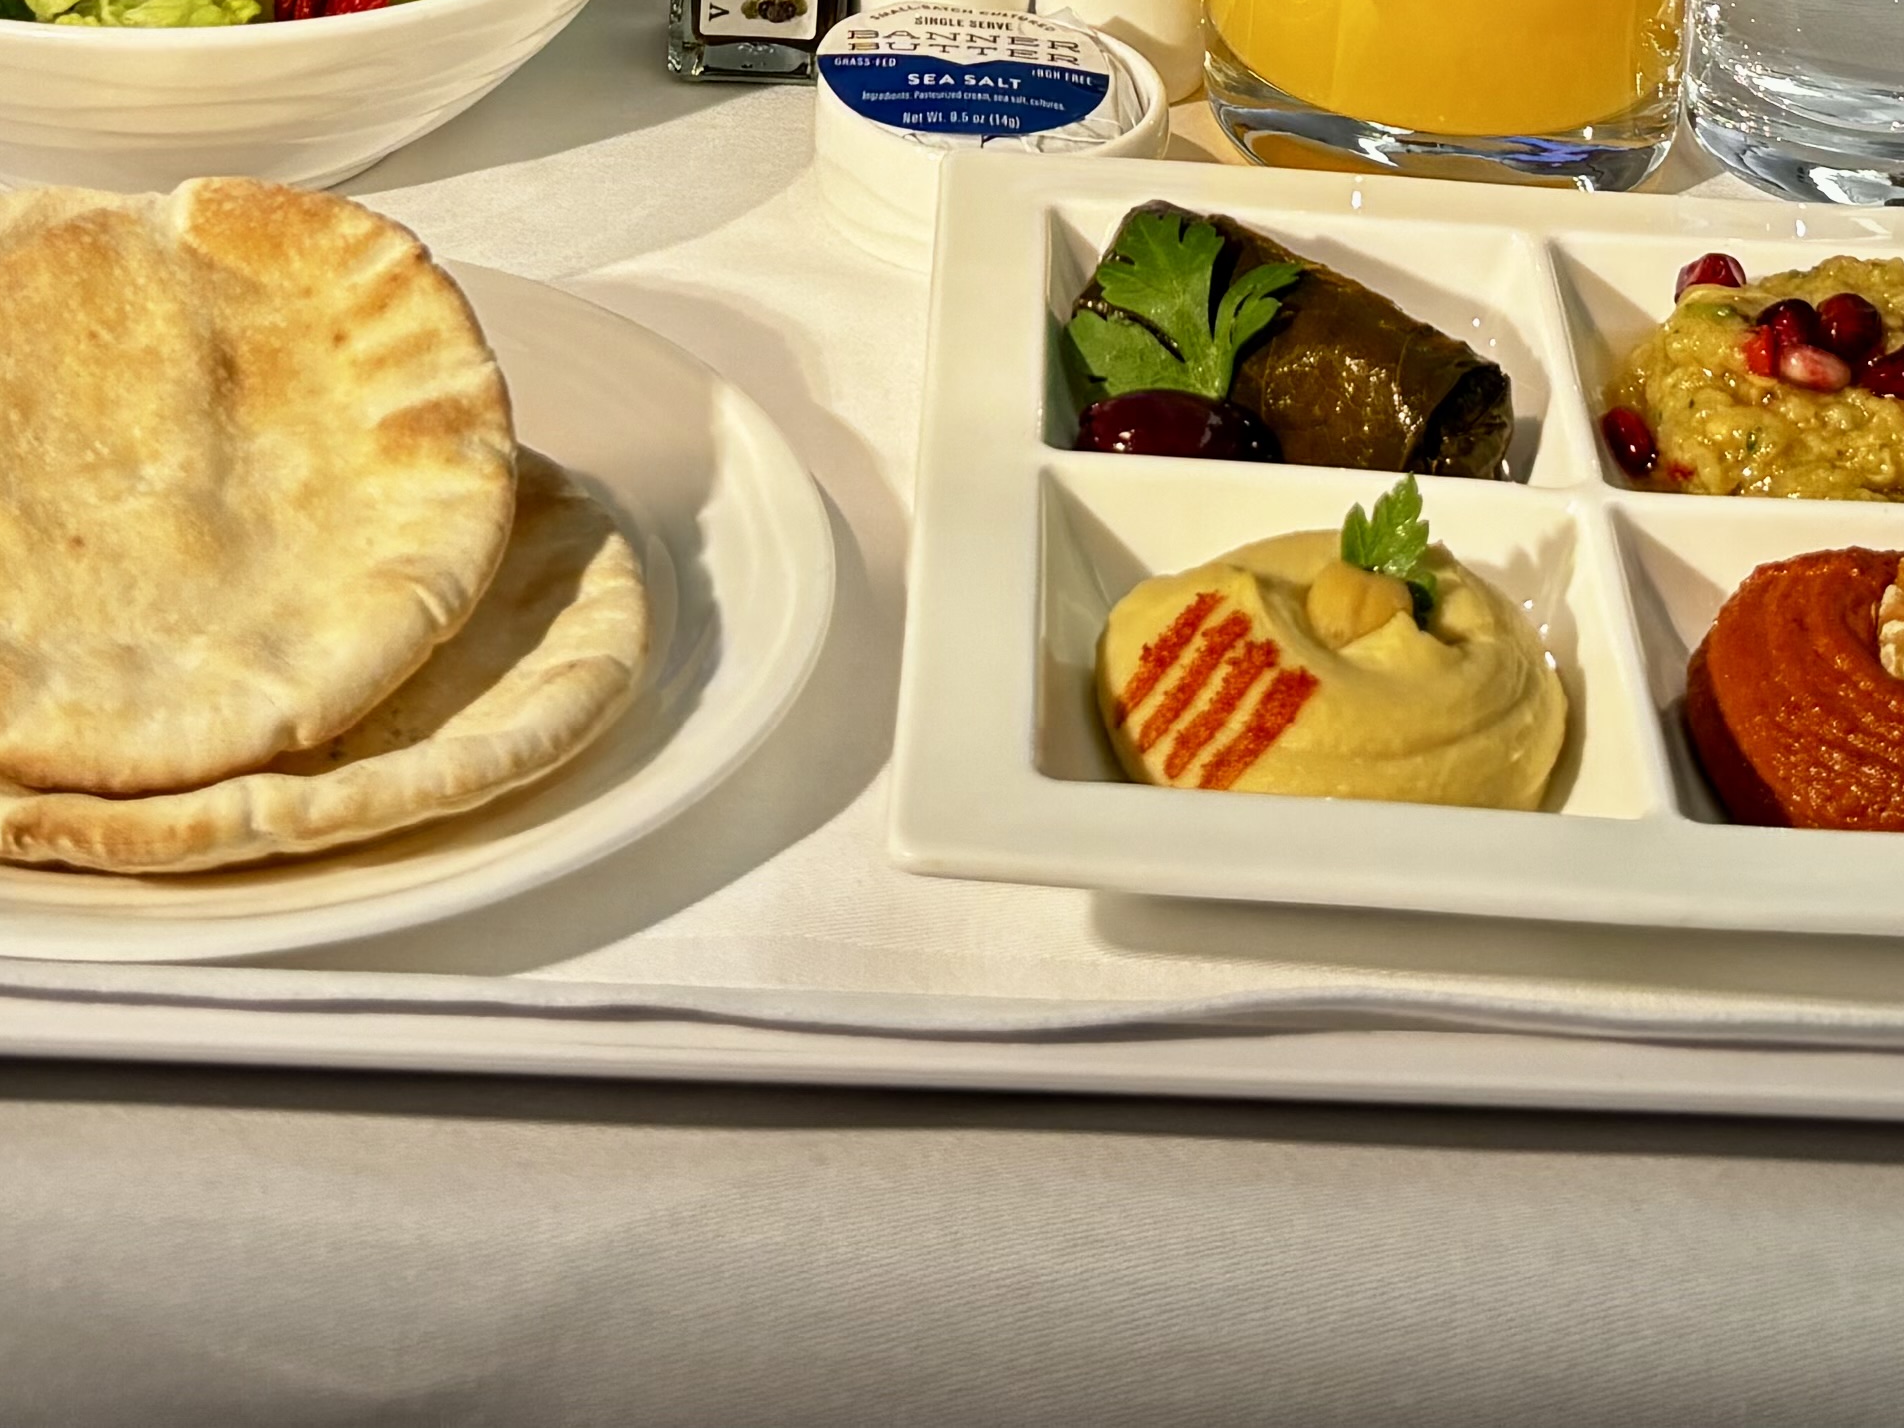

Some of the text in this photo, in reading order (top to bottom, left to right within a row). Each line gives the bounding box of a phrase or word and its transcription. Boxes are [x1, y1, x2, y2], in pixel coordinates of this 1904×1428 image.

[914, 16, 1014, 32] SINGLE SERVE
[847, 29, 1081, 53] BANNER
[847, 41, 1080, 66] BUTTER
[908, 73, 1022, 89] SEA SALT
[913, 90, 962, 101] Pasteurized
[902, 111, 923, 124] Net
[926, 111, 946, 123] Wt.
[972, 113, 985, 124] oz
[989, 112, 1021, 130] (14g)
